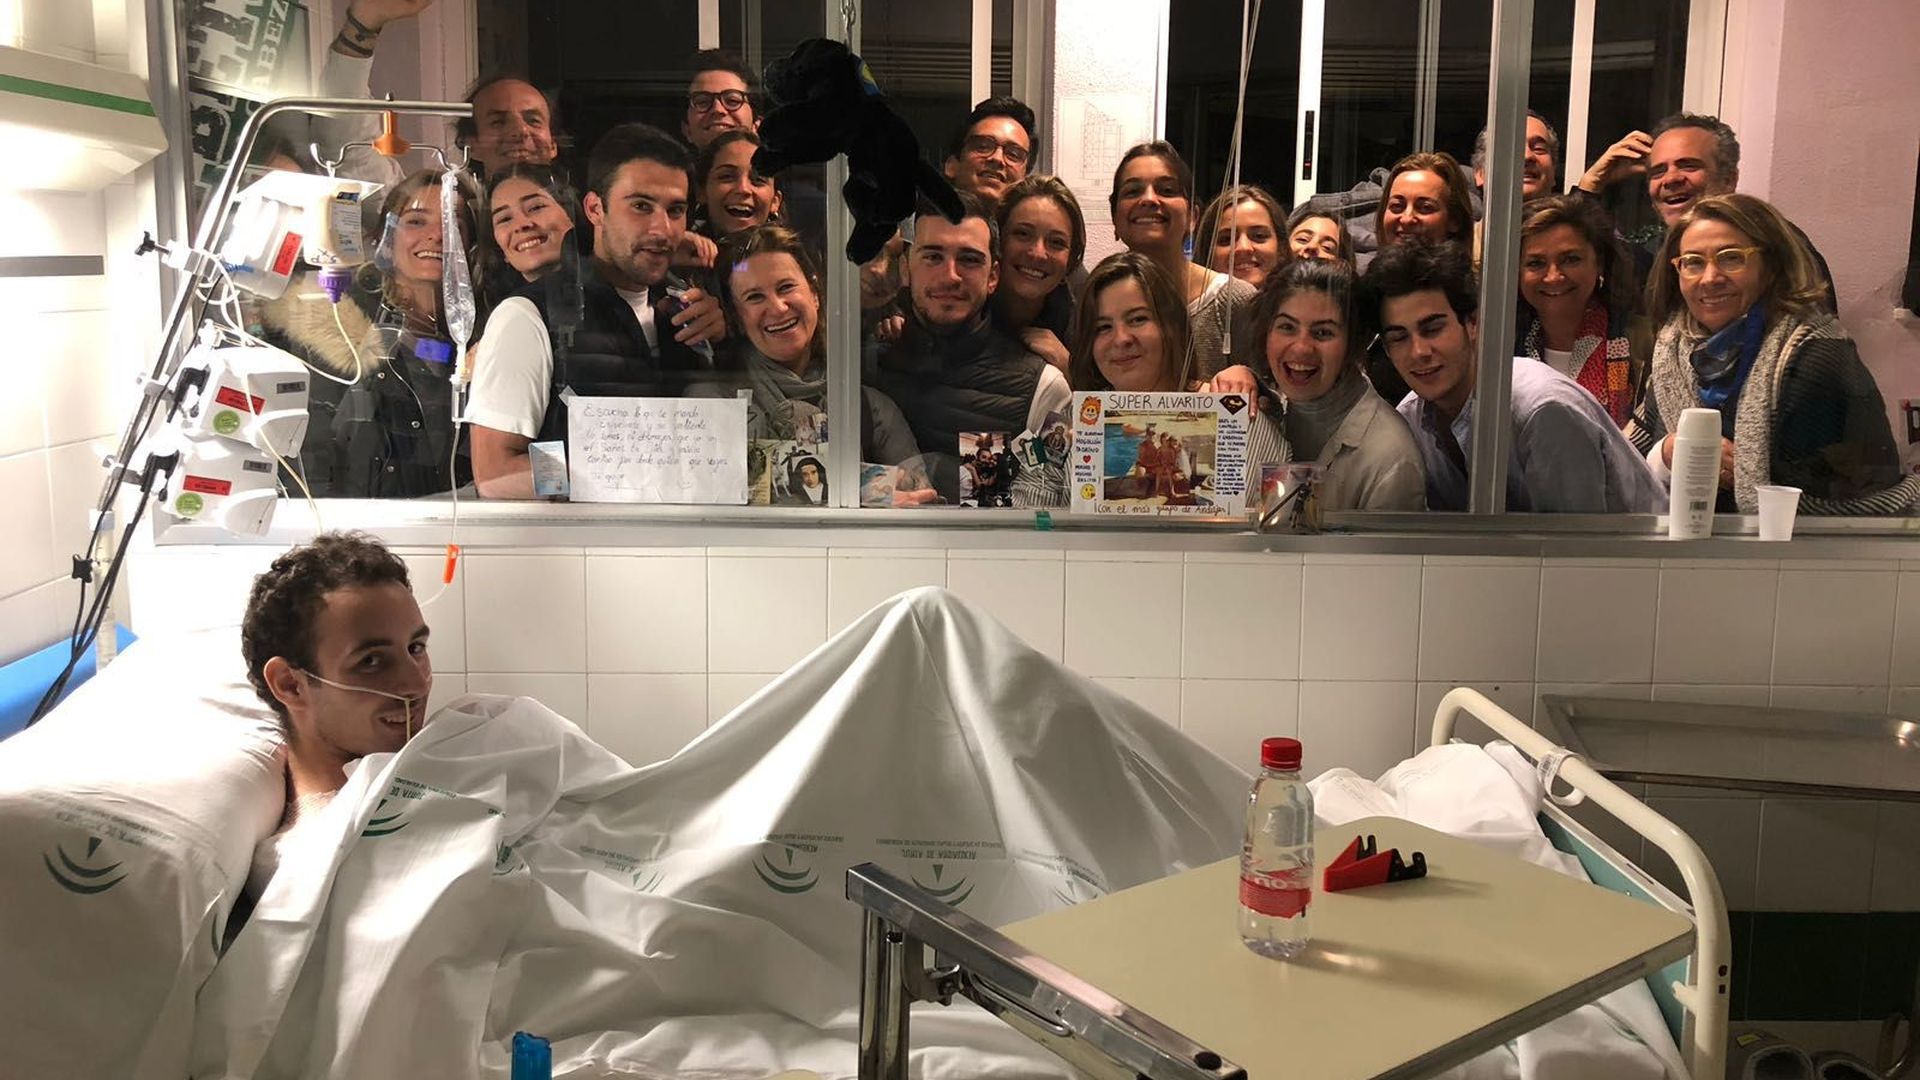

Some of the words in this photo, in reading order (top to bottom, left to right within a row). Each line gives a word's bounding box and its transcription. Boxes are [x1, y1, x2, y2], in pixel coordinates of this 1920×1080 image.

[1109, 394, 1151, 409] SUPER
[1158, 394, 1214, 409] ALVARITO
[1182, 504, 1191, 513] de
